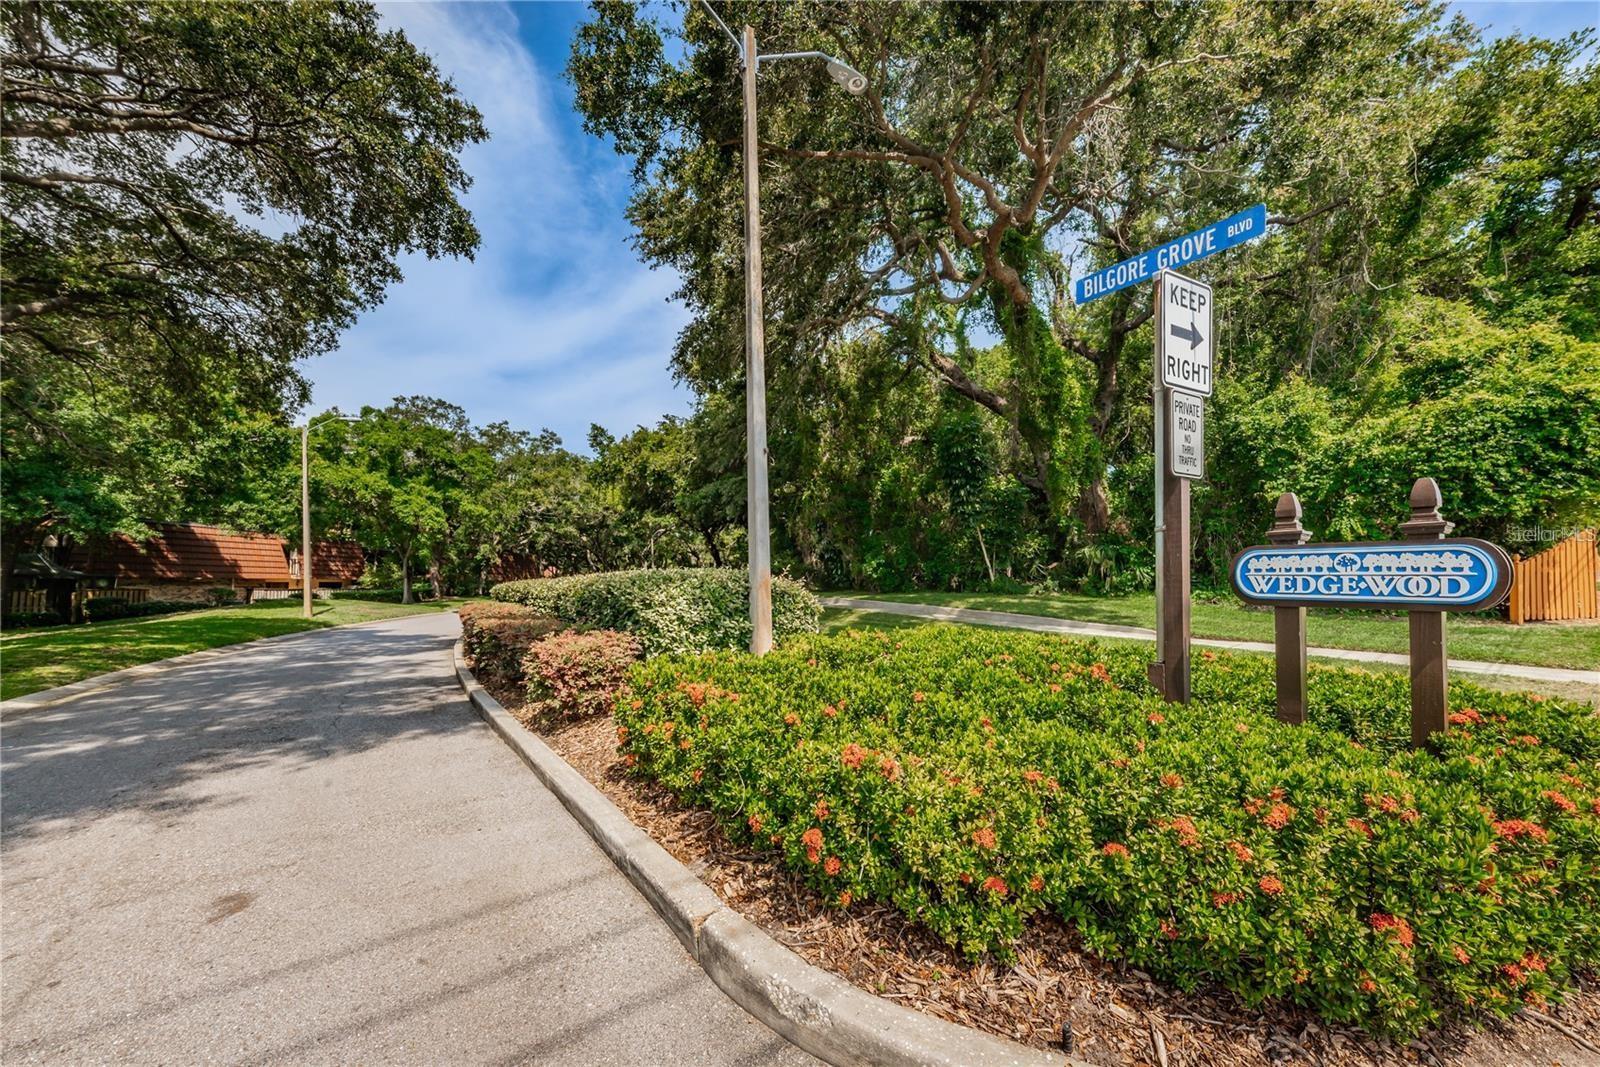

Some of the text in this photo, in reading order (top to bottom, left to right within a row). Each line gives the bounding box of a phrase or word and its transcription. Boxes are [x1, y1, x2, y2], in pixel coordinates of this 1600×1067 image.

[1083, 217, 1253, 298] BILGORE GROVE BLVD
[1170, 282, 1207, 313] KEEP
[1167, 355, 1208, 384] RIGHT
[1174, 400, 1200, 418] PRIVATE
[1178, 417, 1197, 433] ROAD
[1184, 434, 1192, 444] NO
[1182, 444, 1195, 456] THRU
[1178, 455, 1197, 467] TRAFFIC
